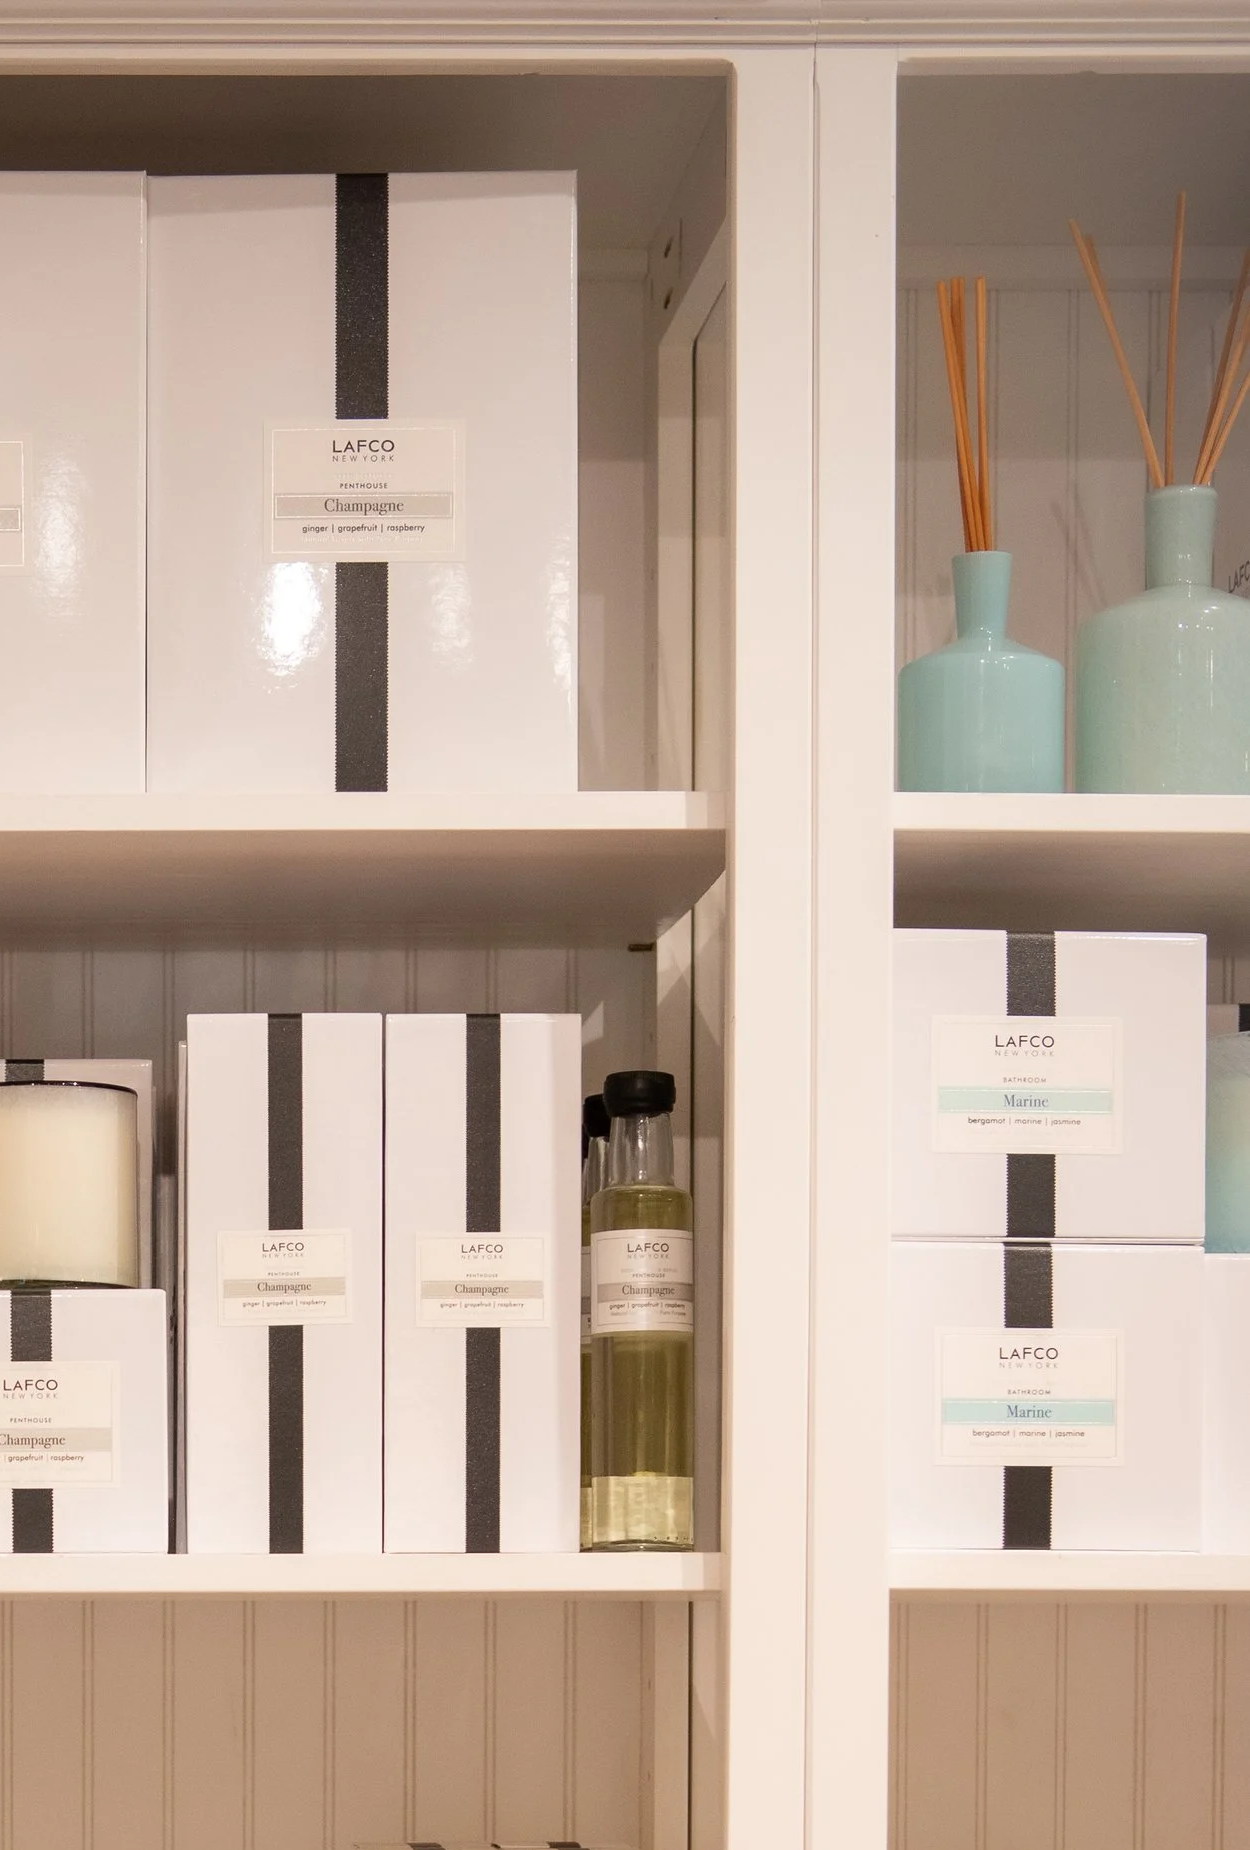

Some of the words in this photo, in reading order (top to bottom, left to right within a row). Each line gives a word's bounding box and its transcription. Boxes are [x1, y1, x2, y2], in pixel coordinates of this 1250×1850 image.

[332, 440, 395, 452] LAFCO
[324, 498, 404, 515] Champagne
[302, 524, 328, 533] ginger
[337, 524, 377, 533] grapefruit
[387, 524, 425, 533] raspberry
[1228, 560, 1250, 593] LAFC
[995, 1035, 1054, 1047] LAFCO
[1004, 1094, 1049, 1107] Marine
[968, 1117, 1005, 1125] bergamot
[262, 1243, 304, 1252] LAFCO
[461, 1244, 503, 1253] LAFCO
[627, 1243, 669, 1252] LAFCO
[257, 1282, 311, 1293] Champagne
[455, 1284, 509, 1296] Champagne
[622, 1285, 674, 1296] Champagne
[999, 1348, 1058, 1360] LAFCO
[3, 1380, 58, 1391] LAFCO
[1007, 1405, 1052, 1418] Marine
[972, 1429, 1010, 1438] bergamot
[8, 1454, 43, 1462] grapefruit
[50, 1454, 84, 1462] raspberry
